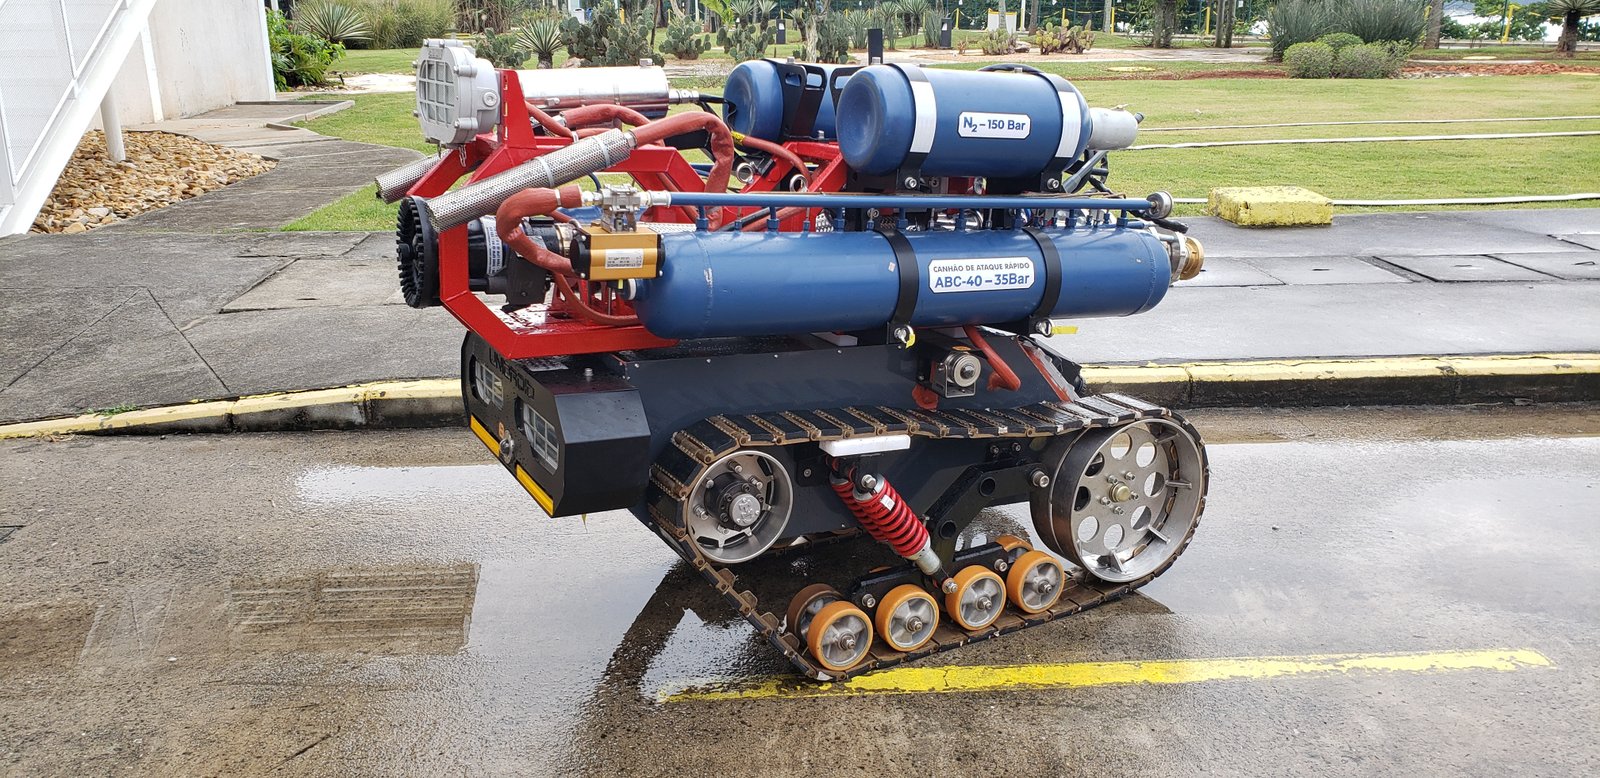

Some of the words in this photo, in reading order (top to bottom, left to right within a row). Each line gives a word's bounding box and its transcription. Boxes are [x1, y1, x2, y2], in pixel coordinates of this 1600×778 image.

[987, 119, 1005, 129] 150
[1007, 119, 1026, 130] Bar
[933, 264, 964, 273] CANHÃO
[965, 264, 975, 272] DE
[976, 263, 1003, 271] ATAQUE
[1004, 261, 1030, 269] RÁPIDO
[934, 275, 982, 288] ABC-40
[994, 272, 1030, 286] 35Bar
